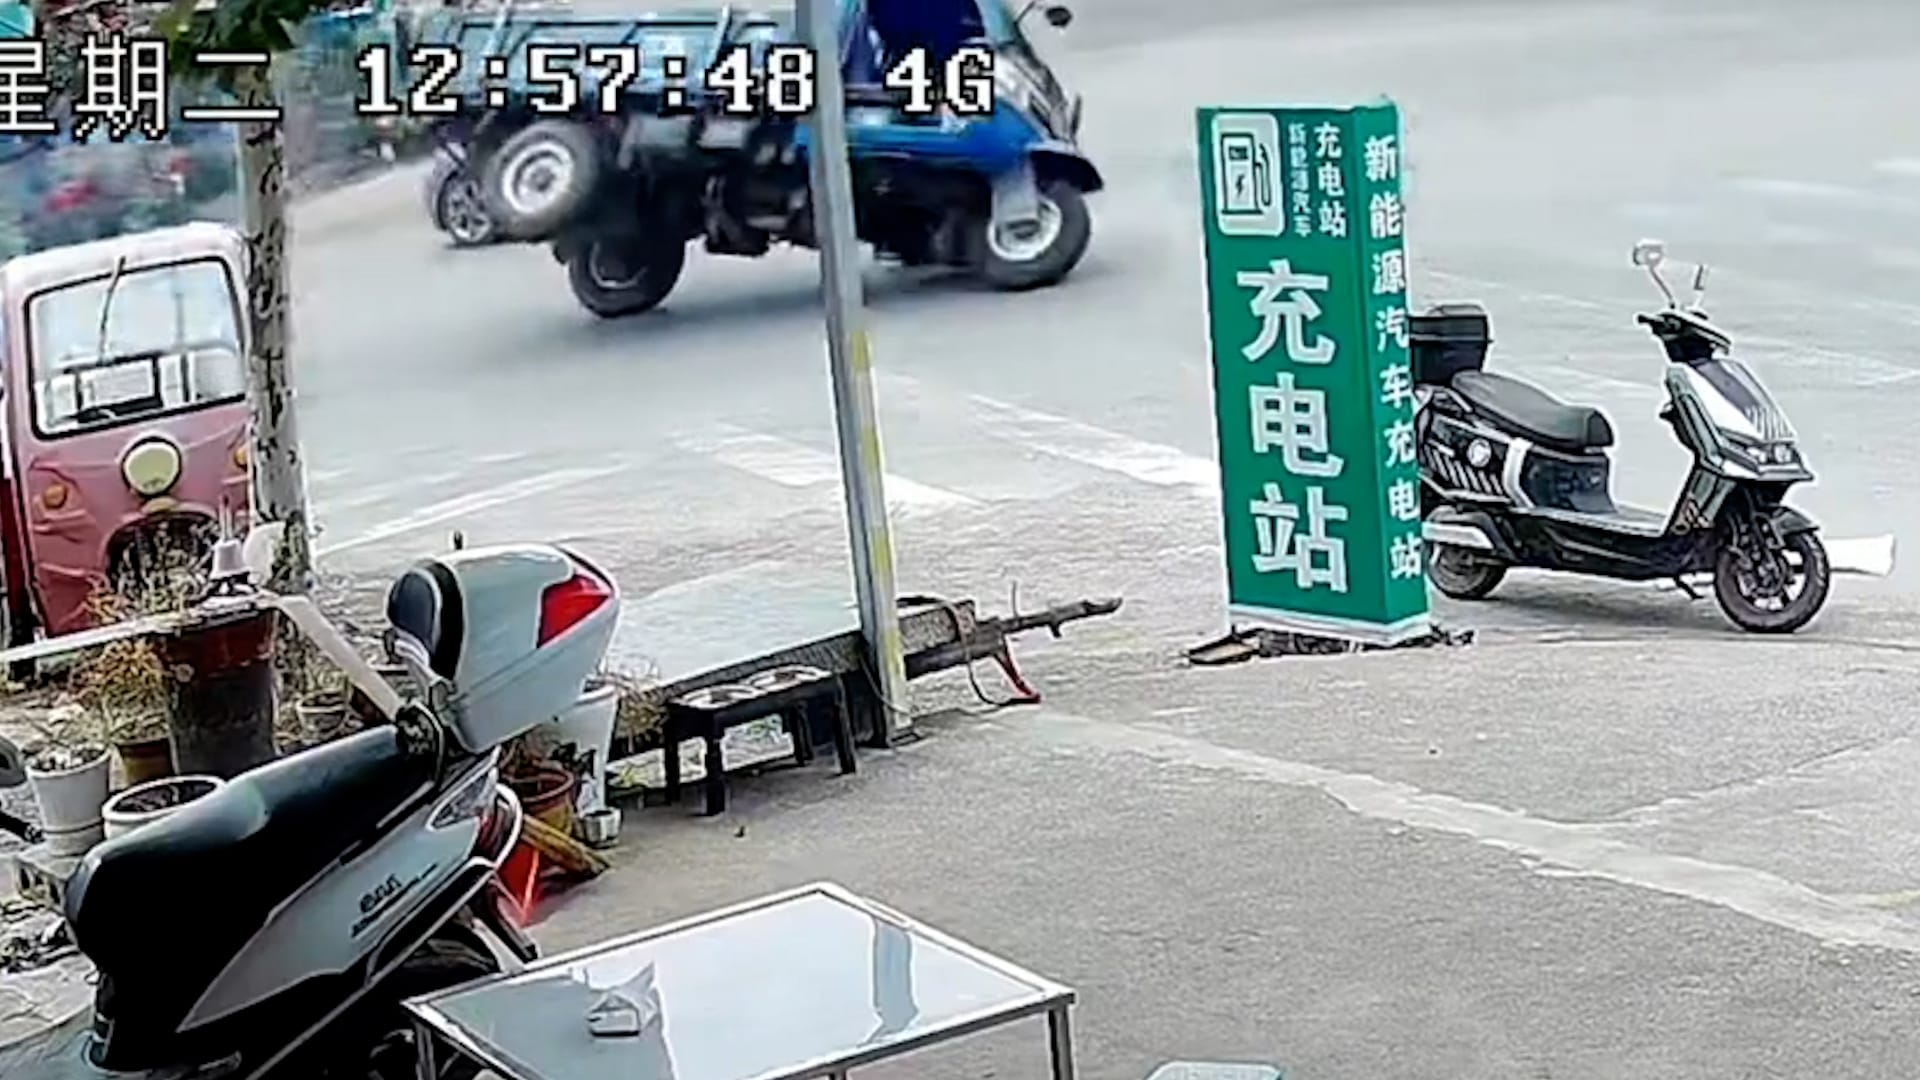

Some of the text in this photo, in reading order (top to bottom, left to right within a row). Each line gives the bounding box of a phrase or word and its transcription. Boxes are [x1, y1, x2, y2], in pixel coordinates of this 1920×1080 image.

[1314, 121, 1347, 237] 充电站
[1236, 258, 1348, 593] 充电站
[1363, 134, 1422, 579] 新能源汽车充电站
